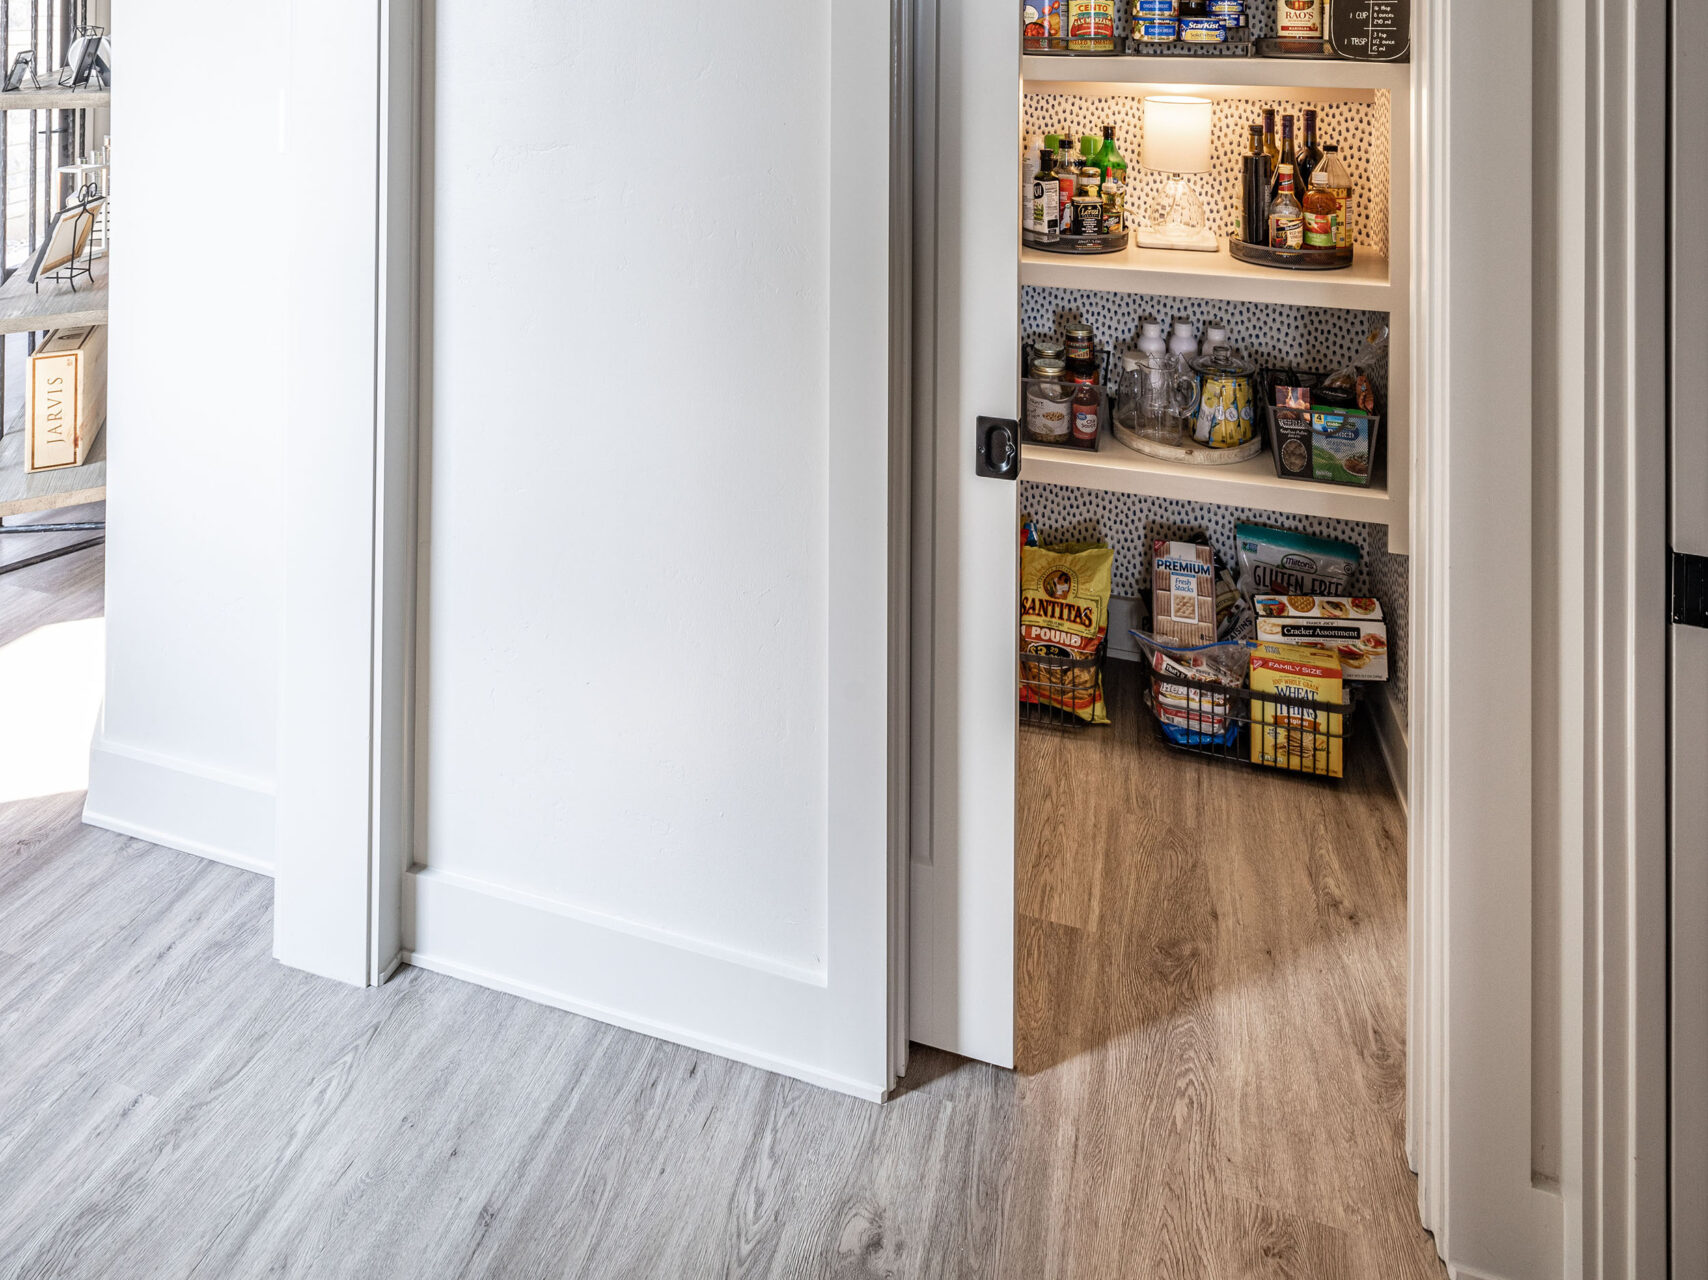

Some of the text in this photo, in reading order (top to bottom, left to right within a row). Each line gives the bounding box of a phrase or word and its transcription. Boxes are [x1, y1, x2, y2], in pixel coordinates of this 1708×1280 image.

[1078, 4, 1108, 12] CENTO
[1286, 11, 1314, 20] RAO'S
[1355, 11, 1369, 19] CUP
[1188, 21, 1220, 30] StarKist
[1350, 37, 1368, 45] TBSP
[46, 376, 65, 444] JARVIS
[1156, 559, 1211, 576] PREMIUM
[1285, 557, 1314, 570] Milton's
[1175, 577, 1192, 586] Fresh
[1253, 564, 1343, 597] GLUTEN FREE
[1174, 584, 1194, 593] Stacks
[1021, 596, 1093, 629] SANTITAS
[1031, 626, 1082, 647] POUND
[1283, 626, 1358, 638] Cracker Assortment
[1268, 661, 1323, 676] FAMILY SIZE
[1284, 679, 1302, 687] WHOLE
[1274, 685, 1319, 701] WHEAT
